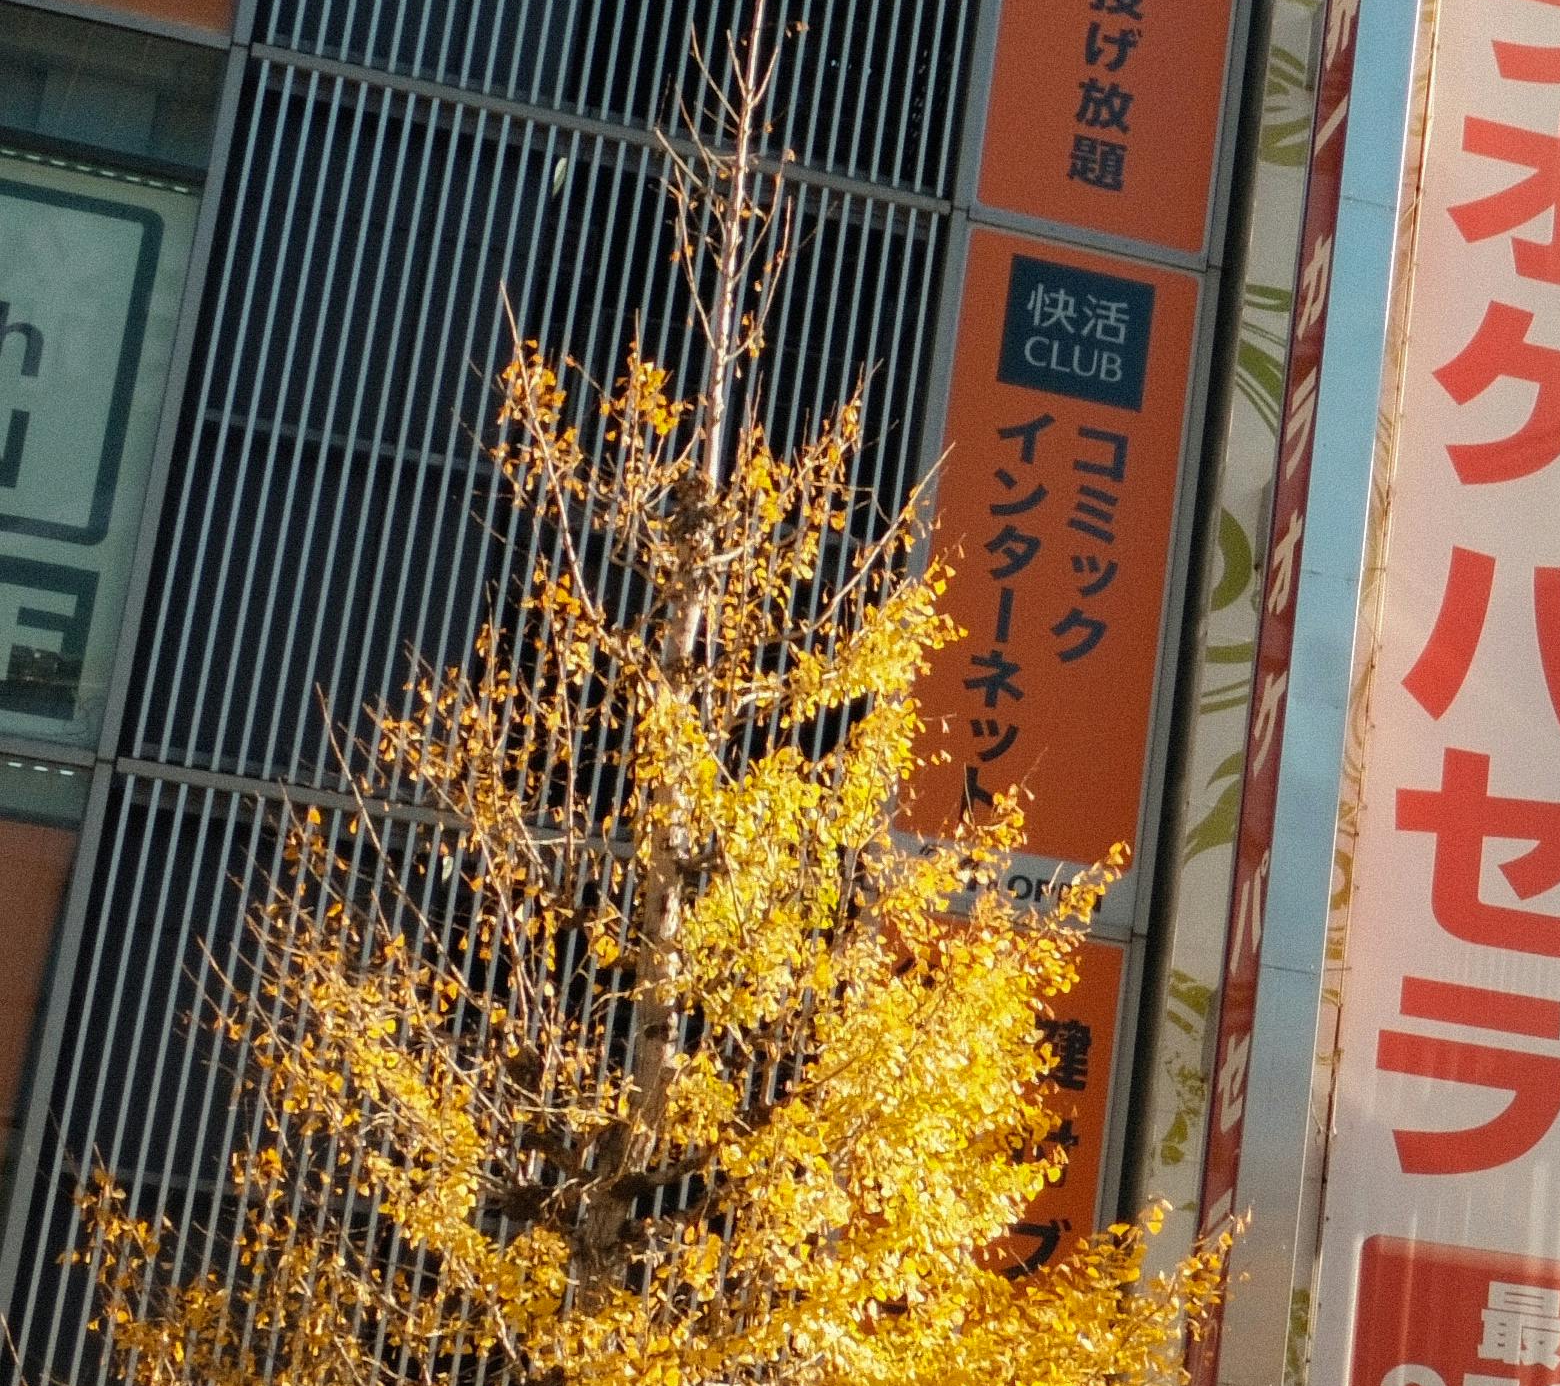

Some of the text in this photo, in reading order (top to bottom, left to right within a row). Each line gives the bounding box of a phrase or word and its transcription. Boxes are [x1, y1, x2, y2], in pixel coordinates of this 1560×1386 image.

[1023, 335, 1124, 384] CLUB
[1024, 281, 1131, 345] 快活
[958, 412, 1057, 825] インターネット
[1049, 426, 1129, 665] コミック
